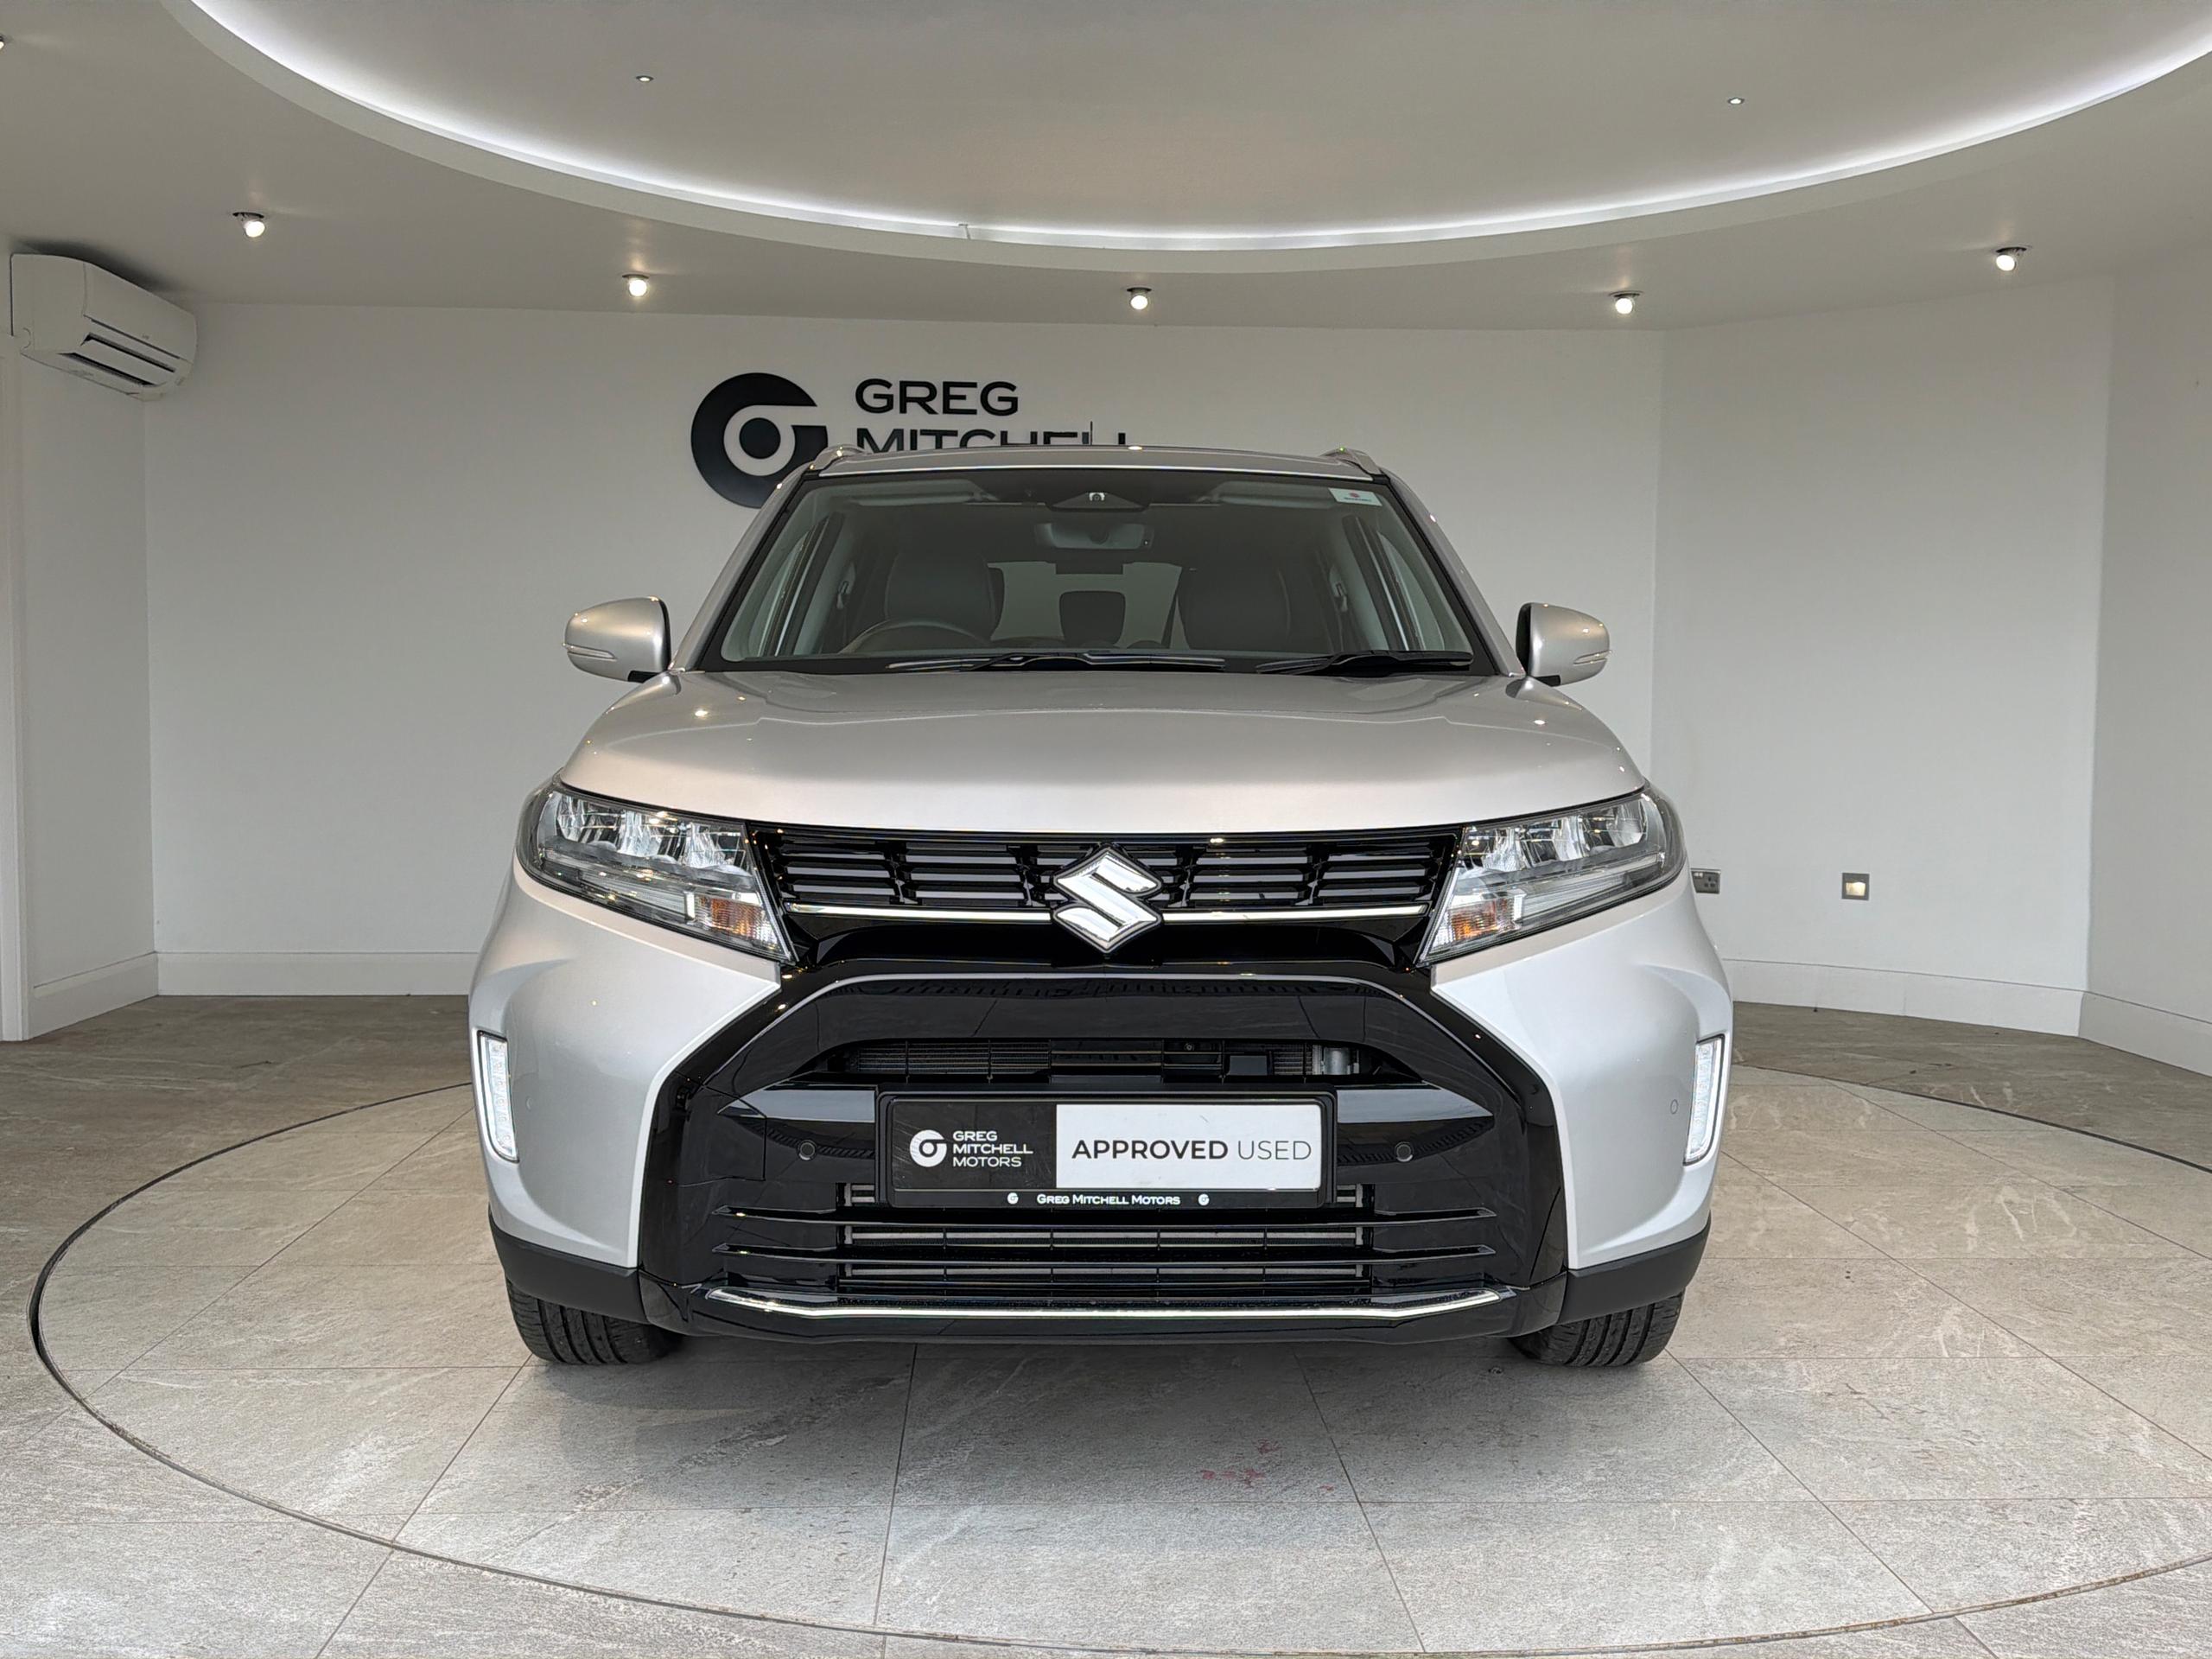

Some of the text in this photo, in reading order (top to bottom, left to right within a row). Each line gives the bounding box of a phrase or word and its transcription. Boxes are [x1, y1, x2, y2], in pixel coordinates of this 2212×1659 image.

[855, 378, 1019, 416] GREG
[952, 1130, 998, 1141] GREG
[952, 1143, 1034, 1154] MITCHELL
[1071, 1140, 1312, 1160] APPROVED USED
[952, 1156, 1022, 1167] MOTORS
[1037, 1193, 1181, 1205] GREG MITCHELL MOTORS
